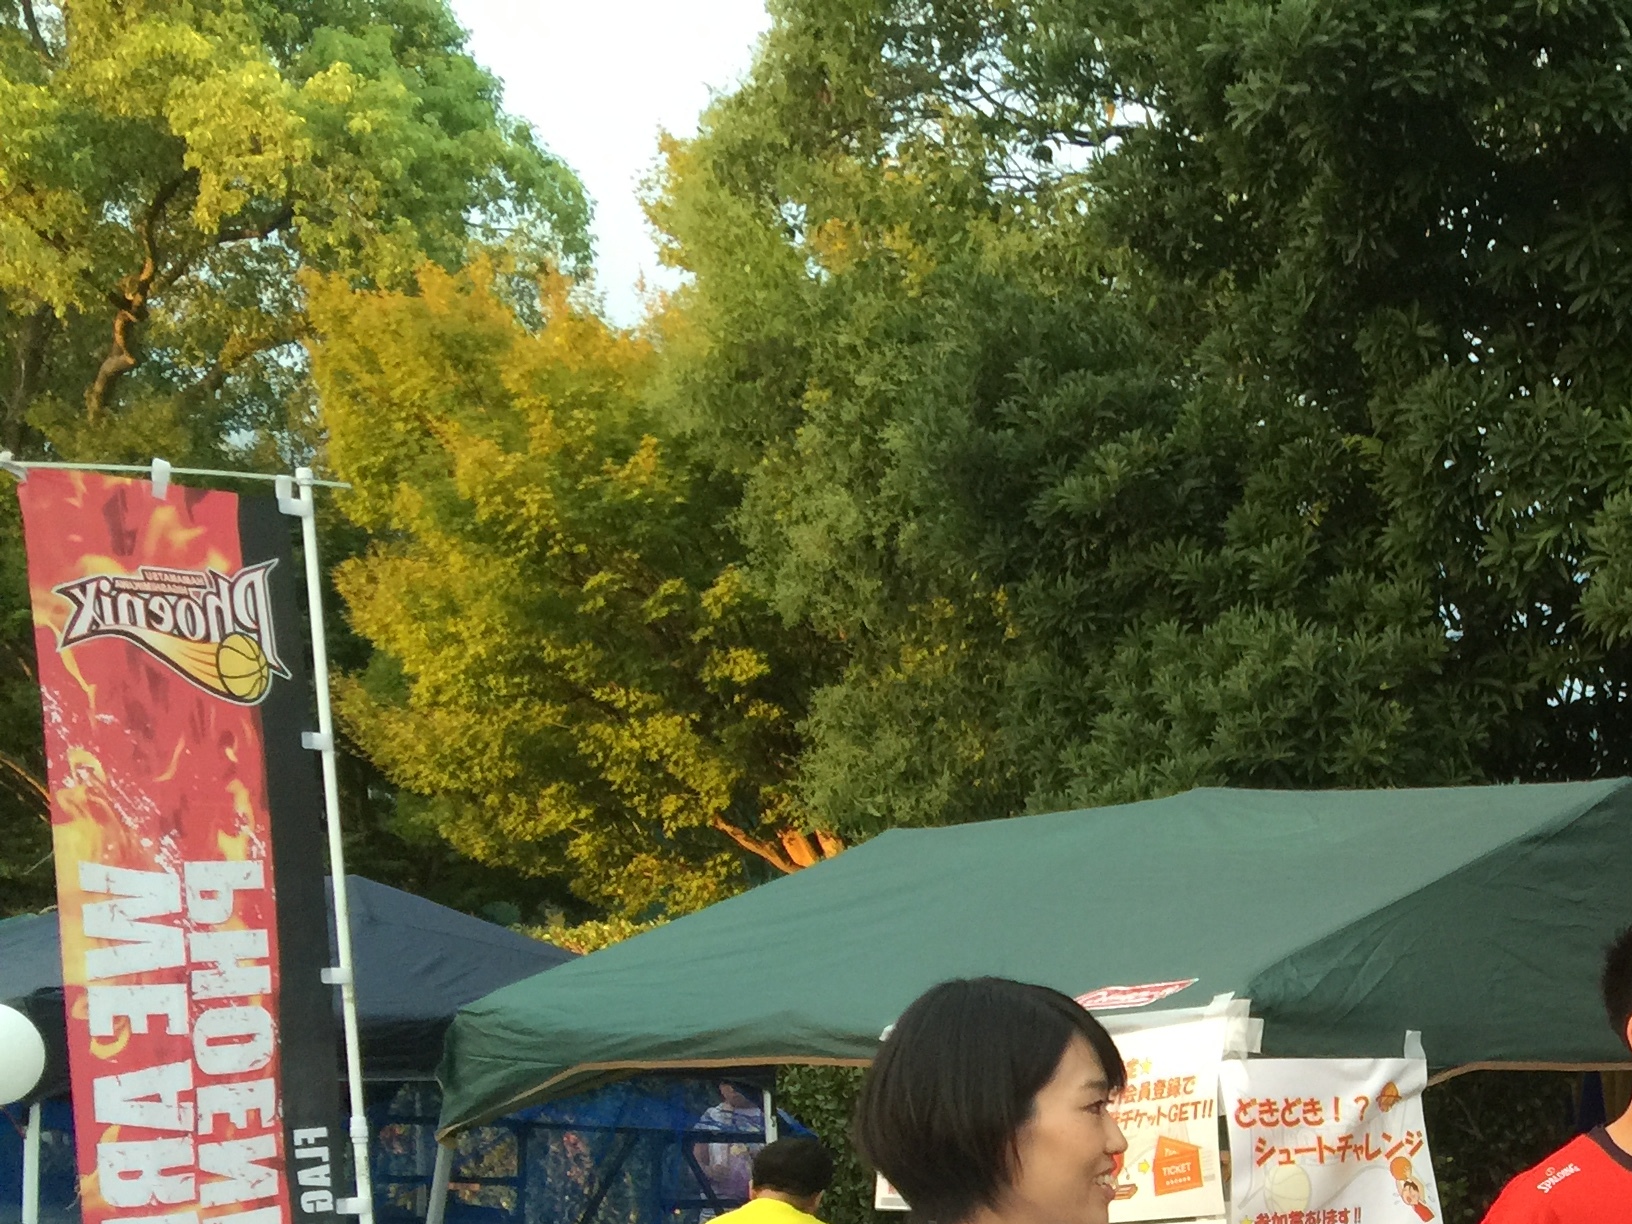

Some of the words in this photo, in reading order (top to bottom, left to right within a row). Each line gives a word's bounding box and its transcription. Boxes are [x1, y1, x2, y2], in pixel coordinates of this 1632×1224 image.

[1253, 1129, 1424, 1169] シュートチャレンジ
[1161, 1161, 1192, 1177] TICKET
[1536, 1162, 1582, 1194] SPALDING
